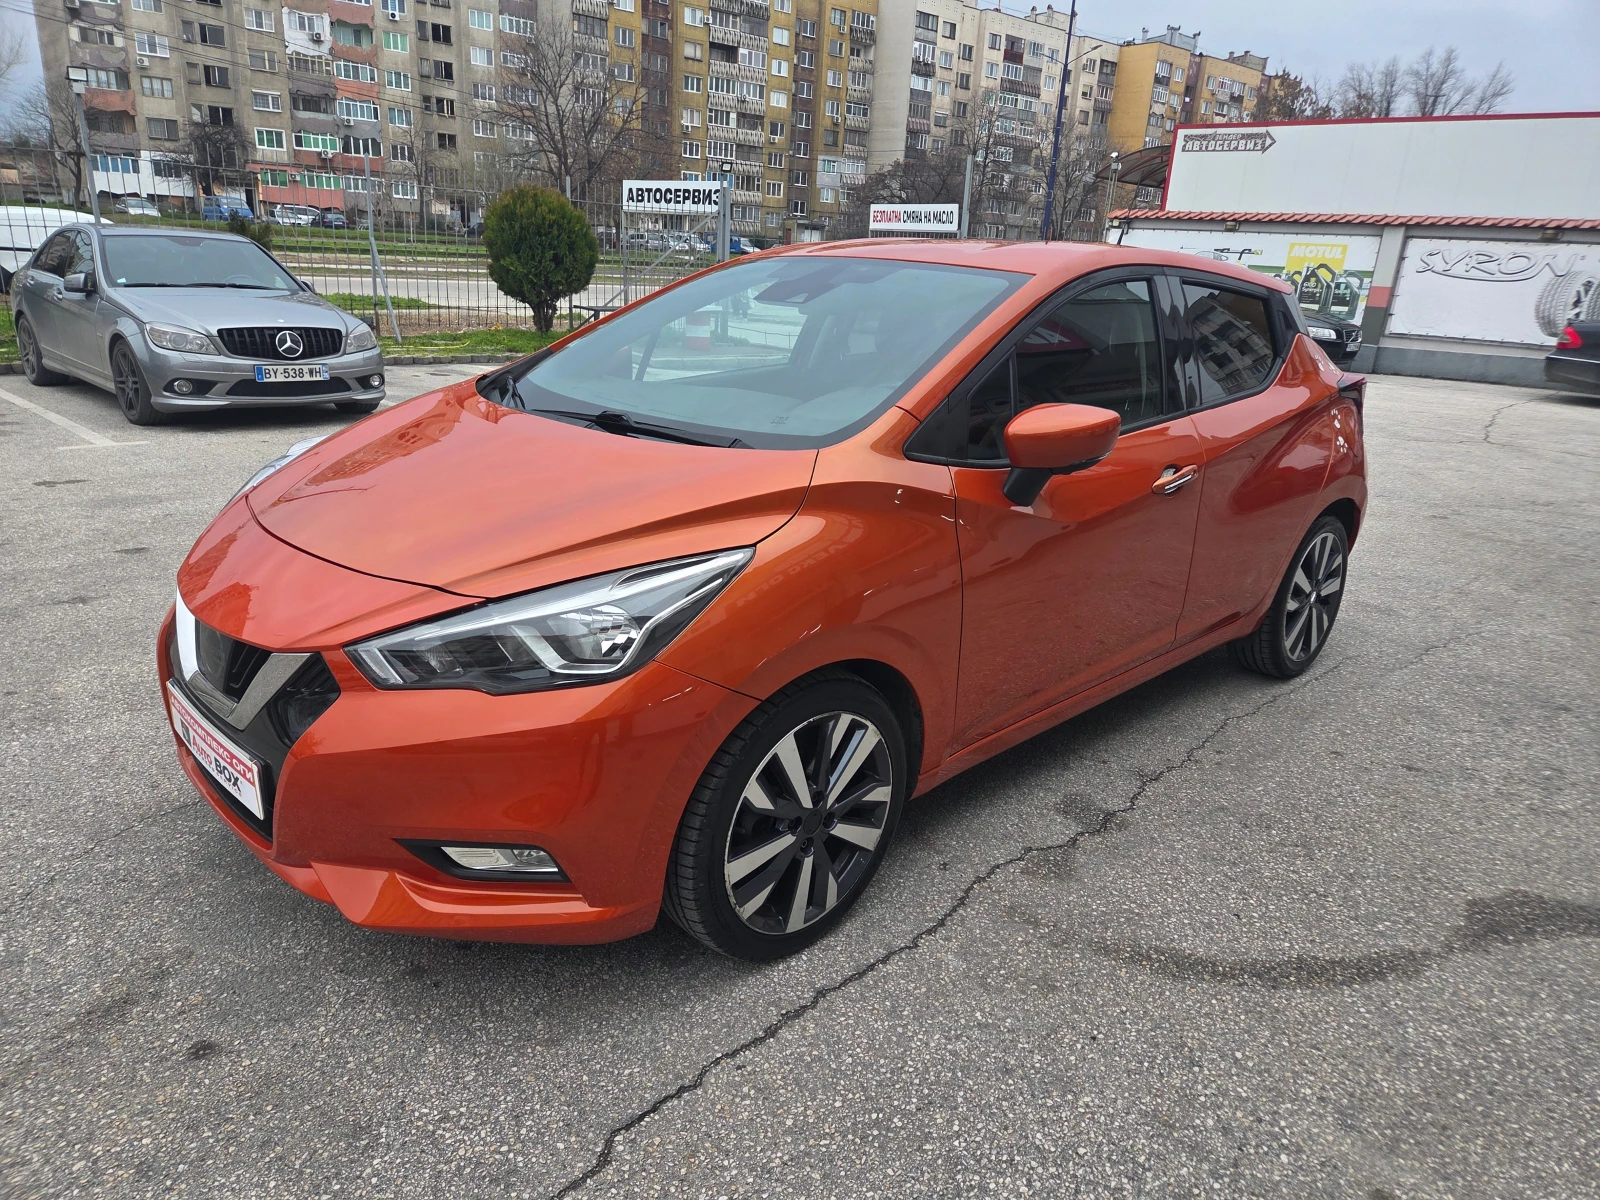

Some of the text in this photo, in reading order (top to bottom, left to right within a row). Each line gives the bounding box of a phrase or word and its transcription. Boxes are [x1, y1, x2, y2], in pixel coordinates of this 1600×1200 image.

[1184, 139, 1263, 151] АВТОСЕРВИЗ
[626, 188, 720, 205] АВТОСЕРВИЗ
[873, 210, 954, 224] БЕЗПЛАТНА СМЯНА НА МАСЛО
[1290, 245, 1343, 259] MOTUL
[1416, 249, 1578, 282] SYRON
[214, 756, 241, 793] BOX
[232, 758, 254, 783] ОГИ
